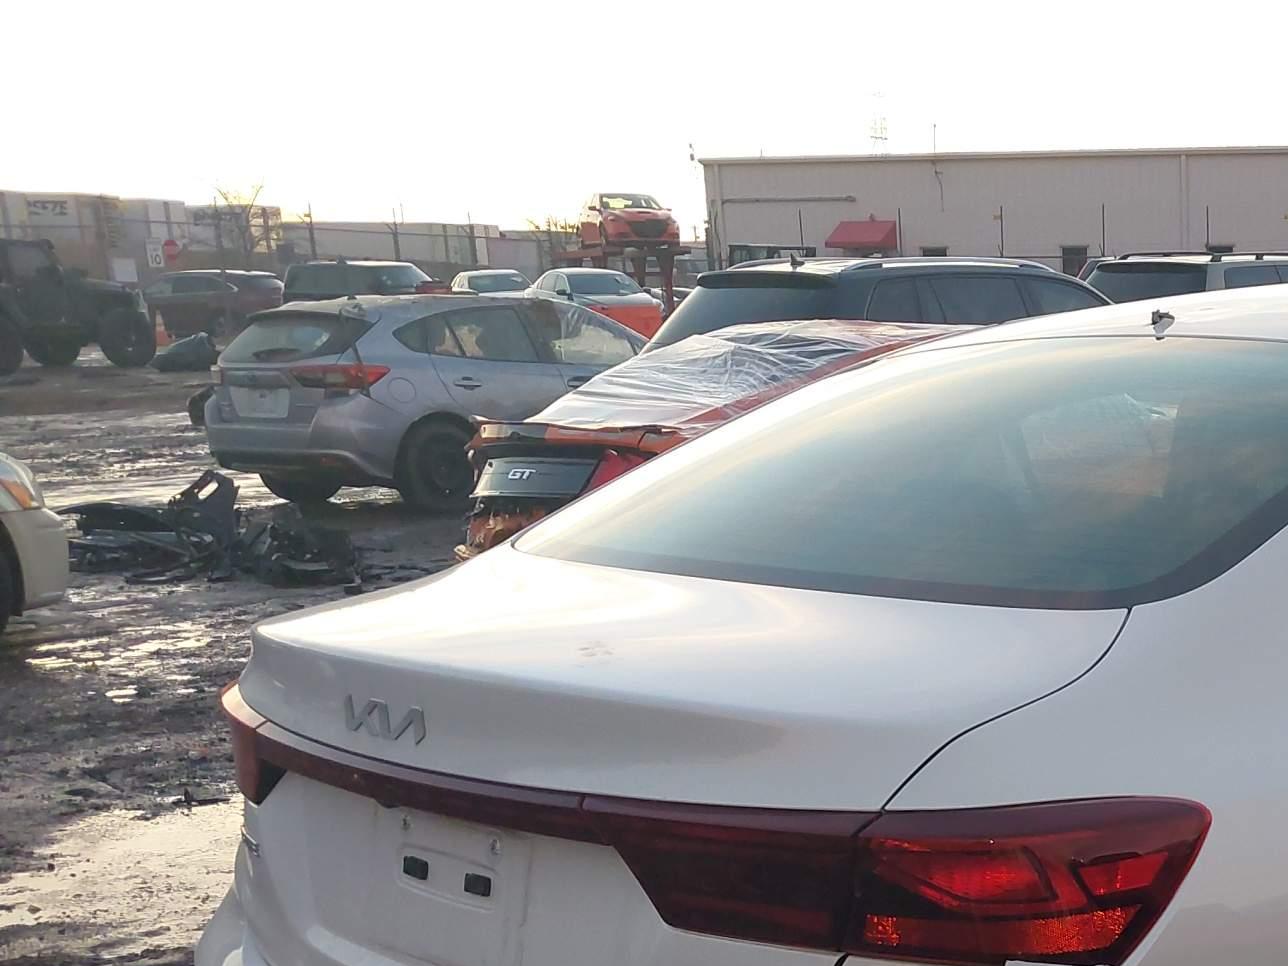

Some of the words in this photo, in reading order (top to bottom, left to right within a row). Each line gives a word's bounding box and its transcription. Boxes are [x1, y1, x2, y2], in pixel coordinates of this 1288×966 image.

[151, 253, 162, 265] 10
[508, 468, 537, 480] GT
[343, 694, 426, 746] KIA
